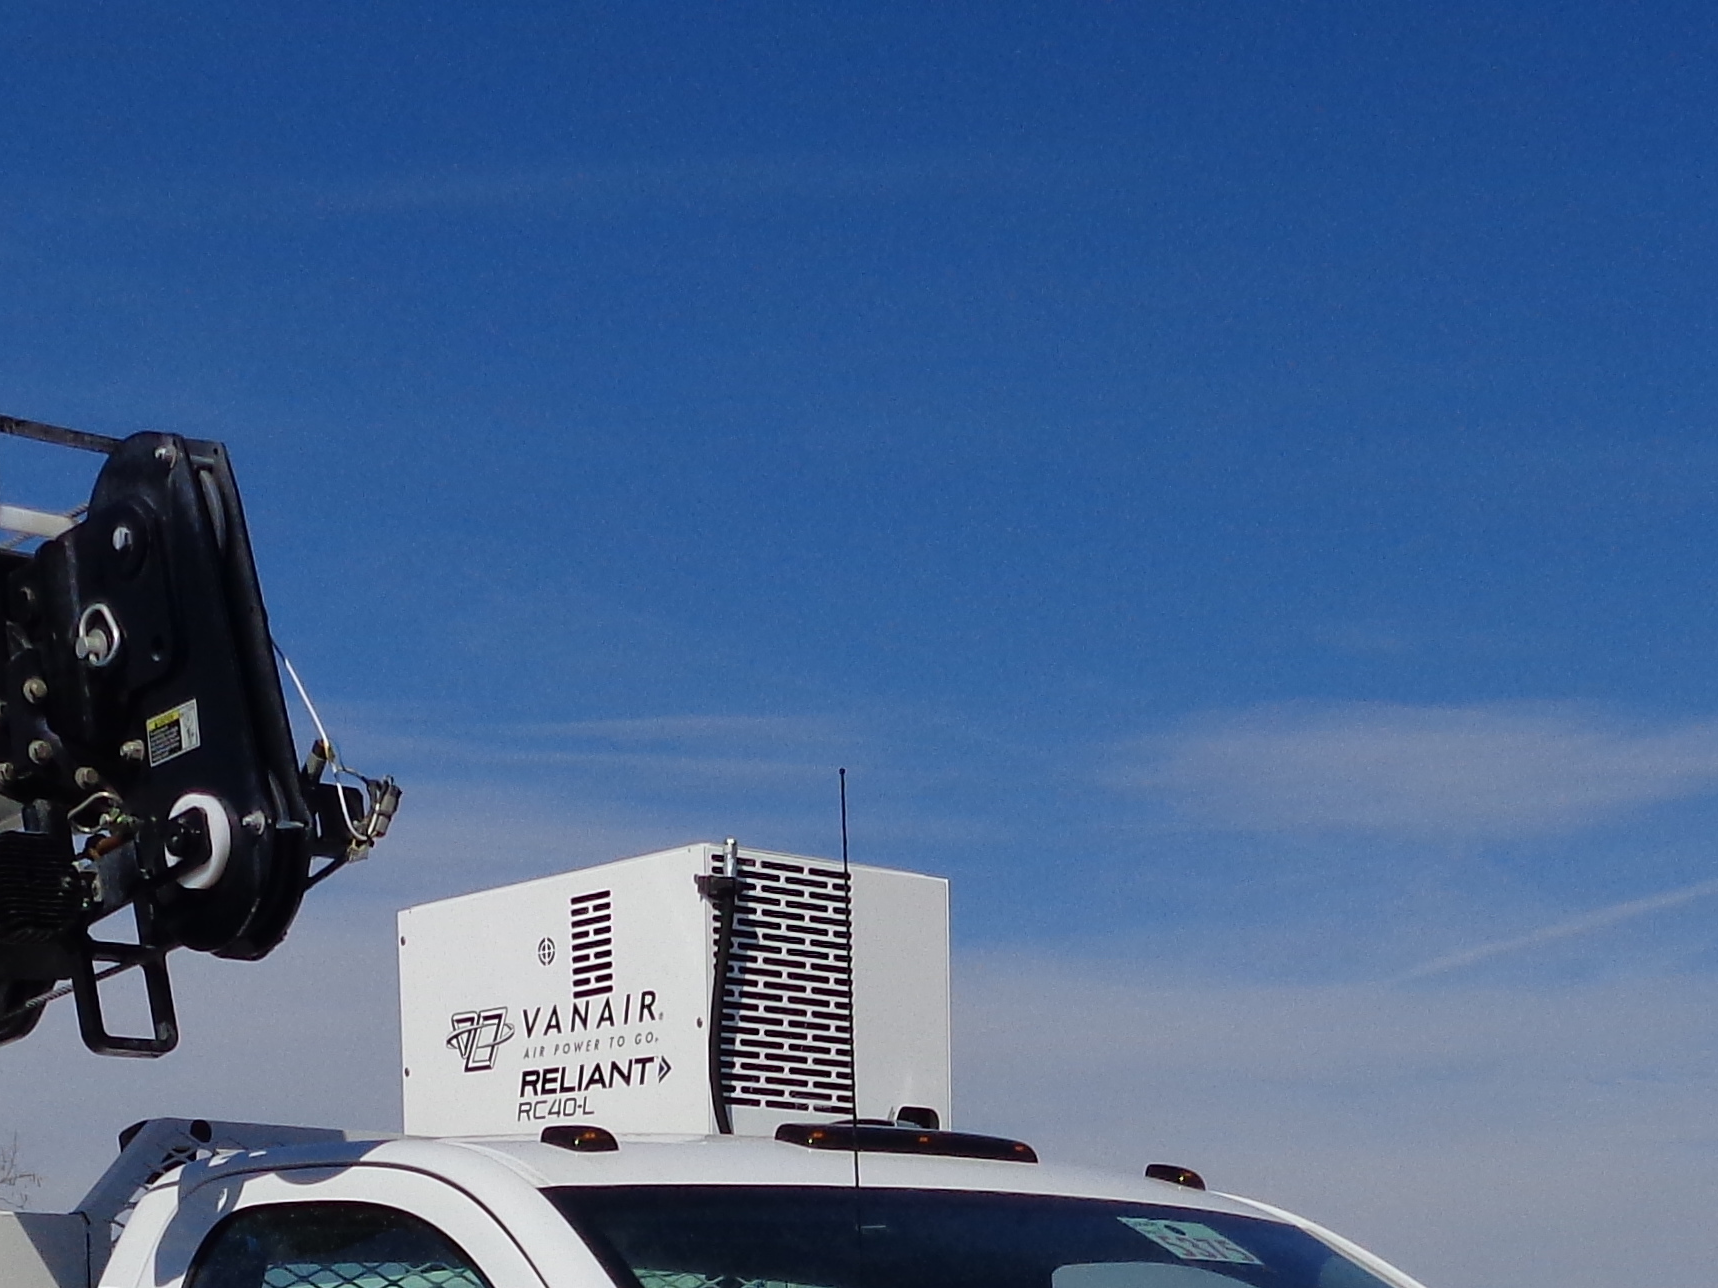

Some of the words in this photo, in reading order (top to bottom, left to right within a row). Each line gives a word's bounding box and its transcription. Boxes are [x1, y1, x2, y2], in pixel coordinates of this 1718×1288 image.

[522, 990, 657, 1039] VANAIR
[523, 1045, 545, 1060] AIR
[553, 1039, 600, 1056] POWER
[609, 1035, 626, 1049] TO
[519, 1056, 656, 1098] RELIANT
[517, 1096, 595, 1122] RC40-L
